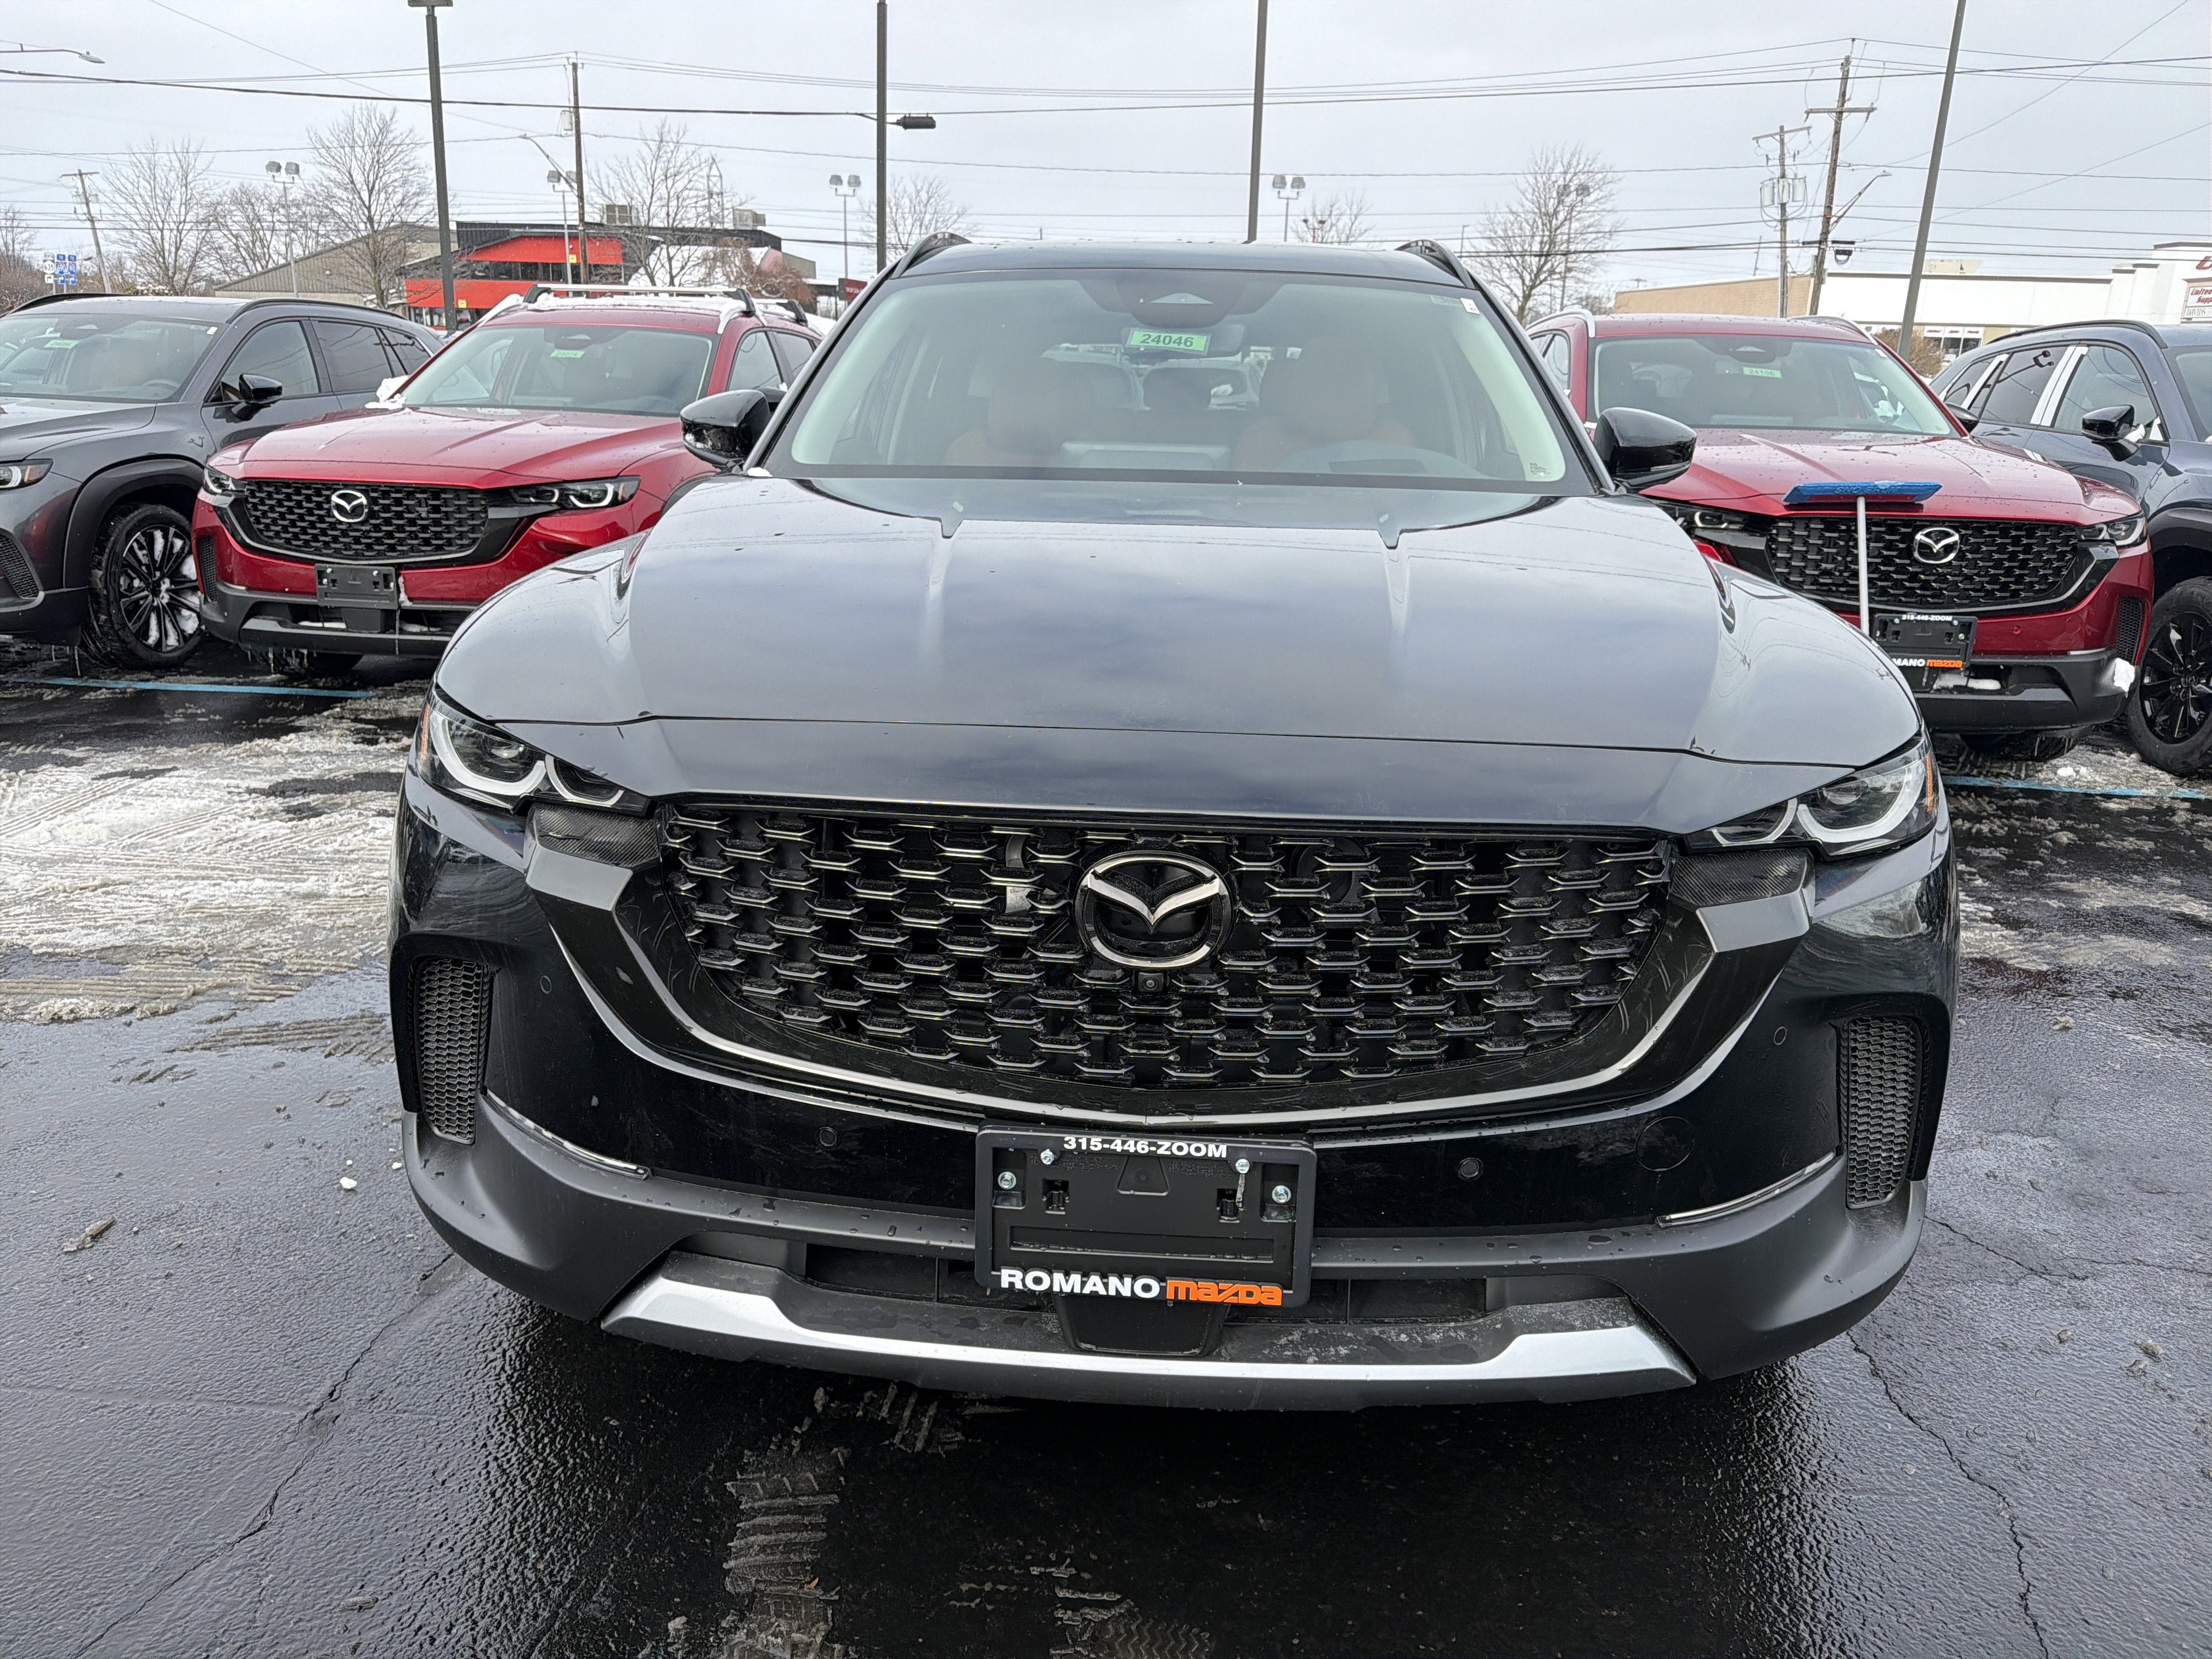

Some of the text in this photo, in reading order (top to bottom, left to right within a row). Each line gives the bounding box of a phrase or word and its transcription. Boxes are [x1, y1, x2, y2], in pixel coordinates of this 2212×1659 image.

[57, 263, 66, 273] 690
[69, 264, 76, 273] 90
[1140, 334, 1194, 347] 24046
[1892, 658, 1926, 667] MANO
[1063, 1136, 1227, 1158] 315-446-ZOOM
[1000, 1269, 1283, 1306] ROMANO mazda
